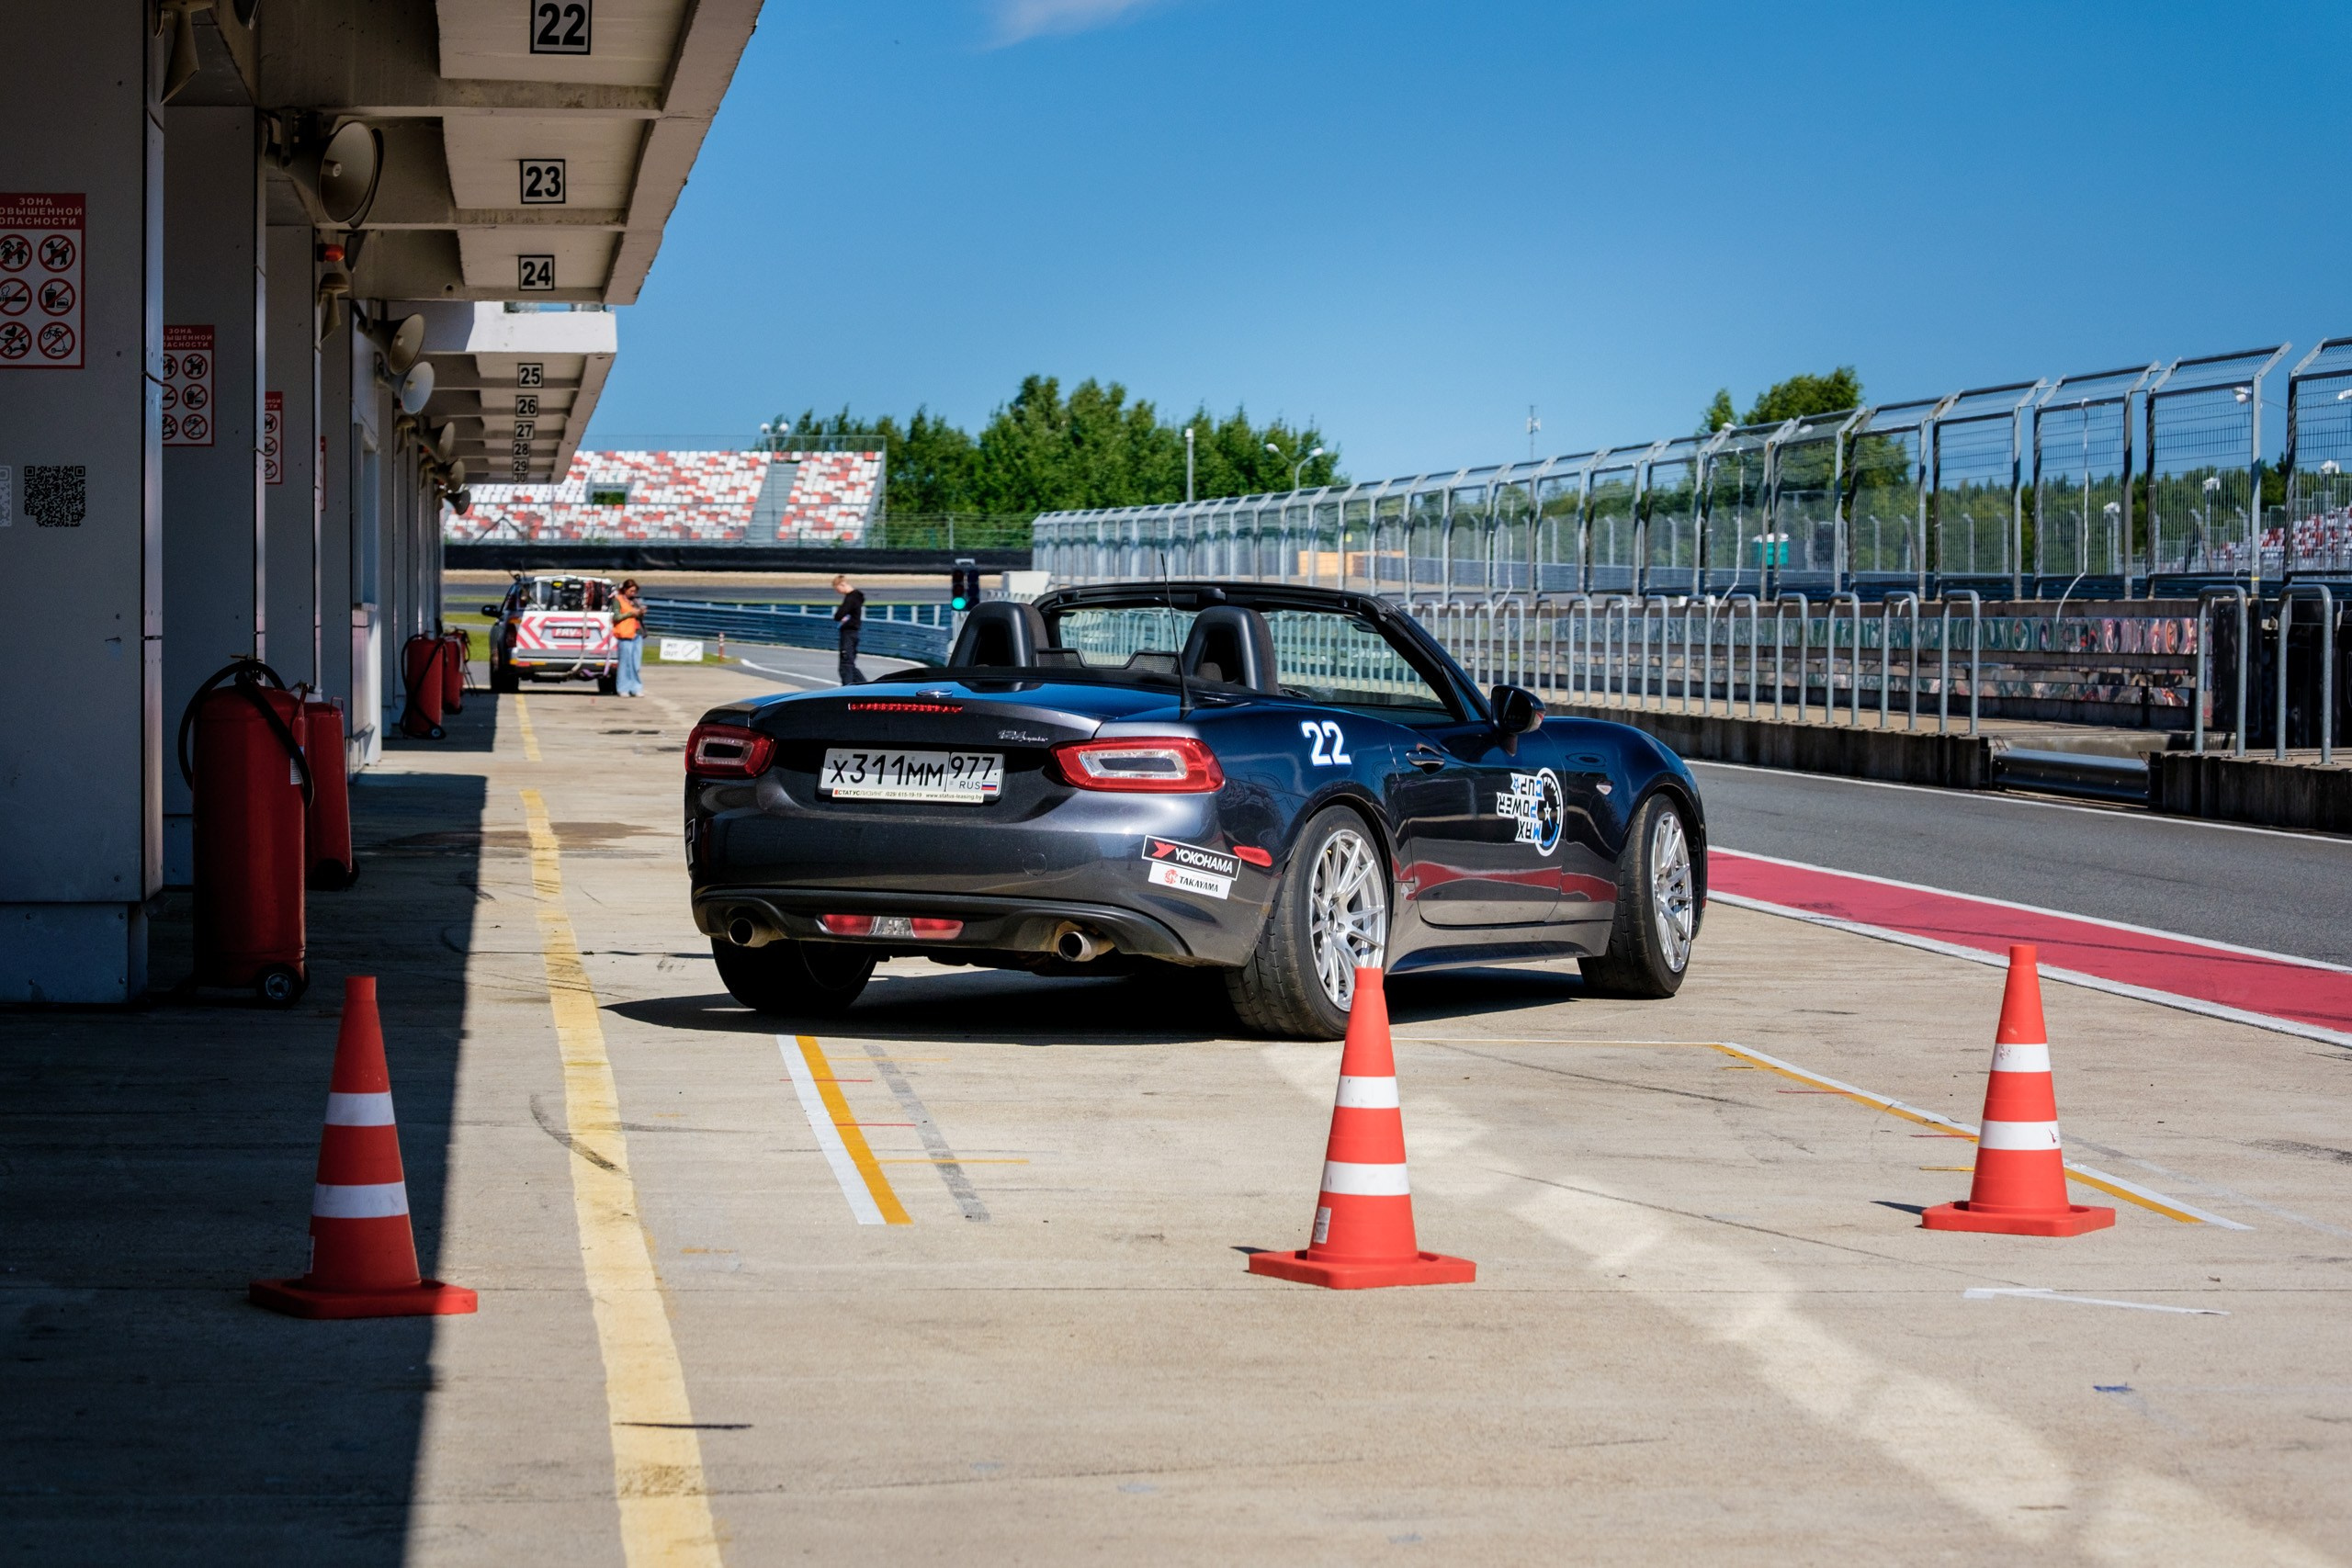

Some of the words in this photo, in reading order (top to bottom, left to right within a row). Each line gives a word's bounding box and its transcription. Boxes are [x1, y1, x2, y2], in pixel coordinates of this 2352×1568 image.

[537, 3, 587, 46] 22
[525, 165, 561, 198] 23
[18, 197, 53, 206] ЗОНА
[0, 206, 83, 216] ОВЫШЕННОЙ
[522, 261, 551, 287] 24
[520, 367, 540, 385] 25
[518, 399, 536, 414] 26
[516, 424, 533, 437] 27
[514, 443, 528, 456] 28
[514, 461, 527, 471] 29
[1301, 720, 1352, 767] 22
[950, 756, 995, 780] 977
[959, 781, 981, 790] RUS
[1498, 795, 1537, 818] POWER
[1518, 820, 1542, 840] MAX
[1174, 848, 1233, 874] YOKOHAMA
[1180, 875, 1218, 893] TAKAYAMA
